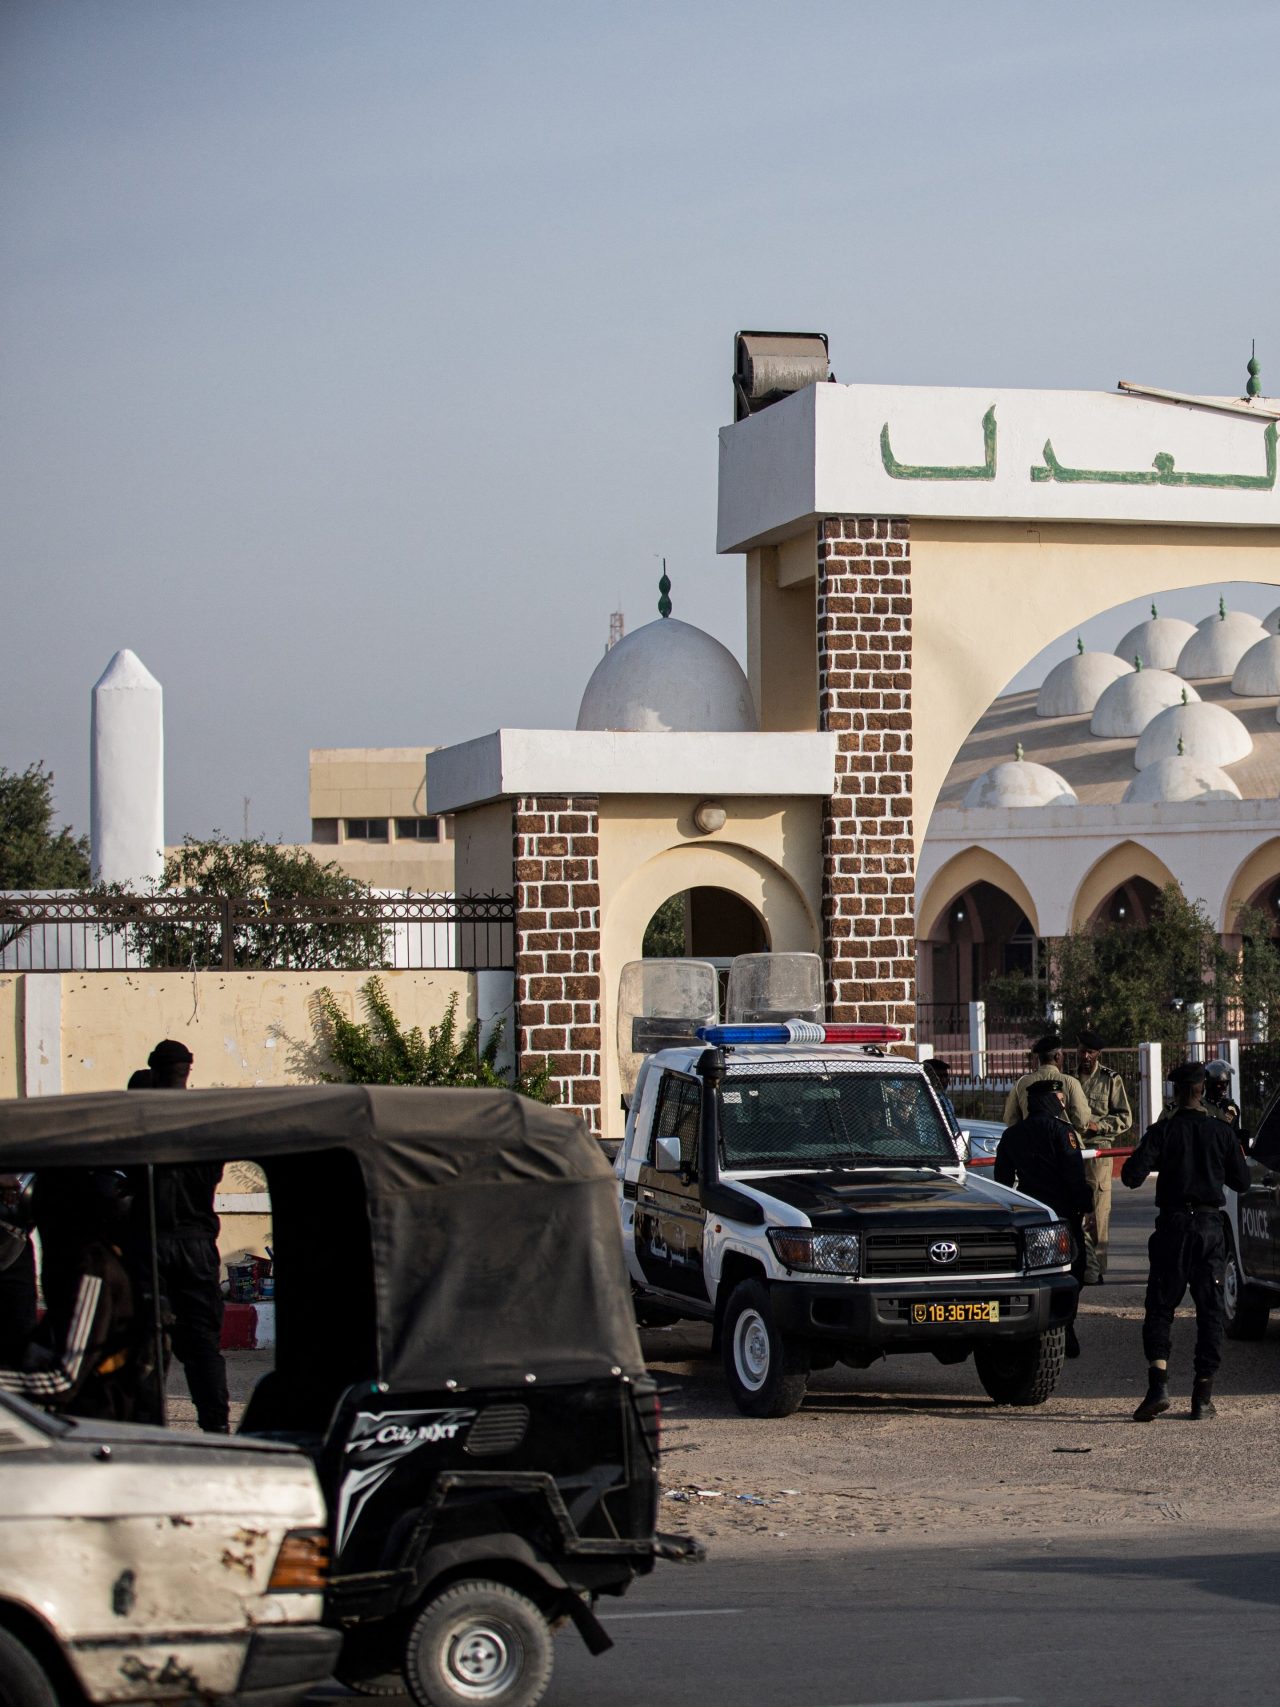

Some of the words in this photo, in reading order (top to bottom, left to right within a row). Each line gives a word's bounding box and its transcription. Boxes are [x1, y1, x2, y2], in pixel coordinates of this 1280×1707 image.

[1241, 1207, 1270, 1239] POLICE
[929, 1304, 990, 1321] 18-36752
[376, 1424, 417, 1444] City
[418, 1422, 459, 1442] NXT
